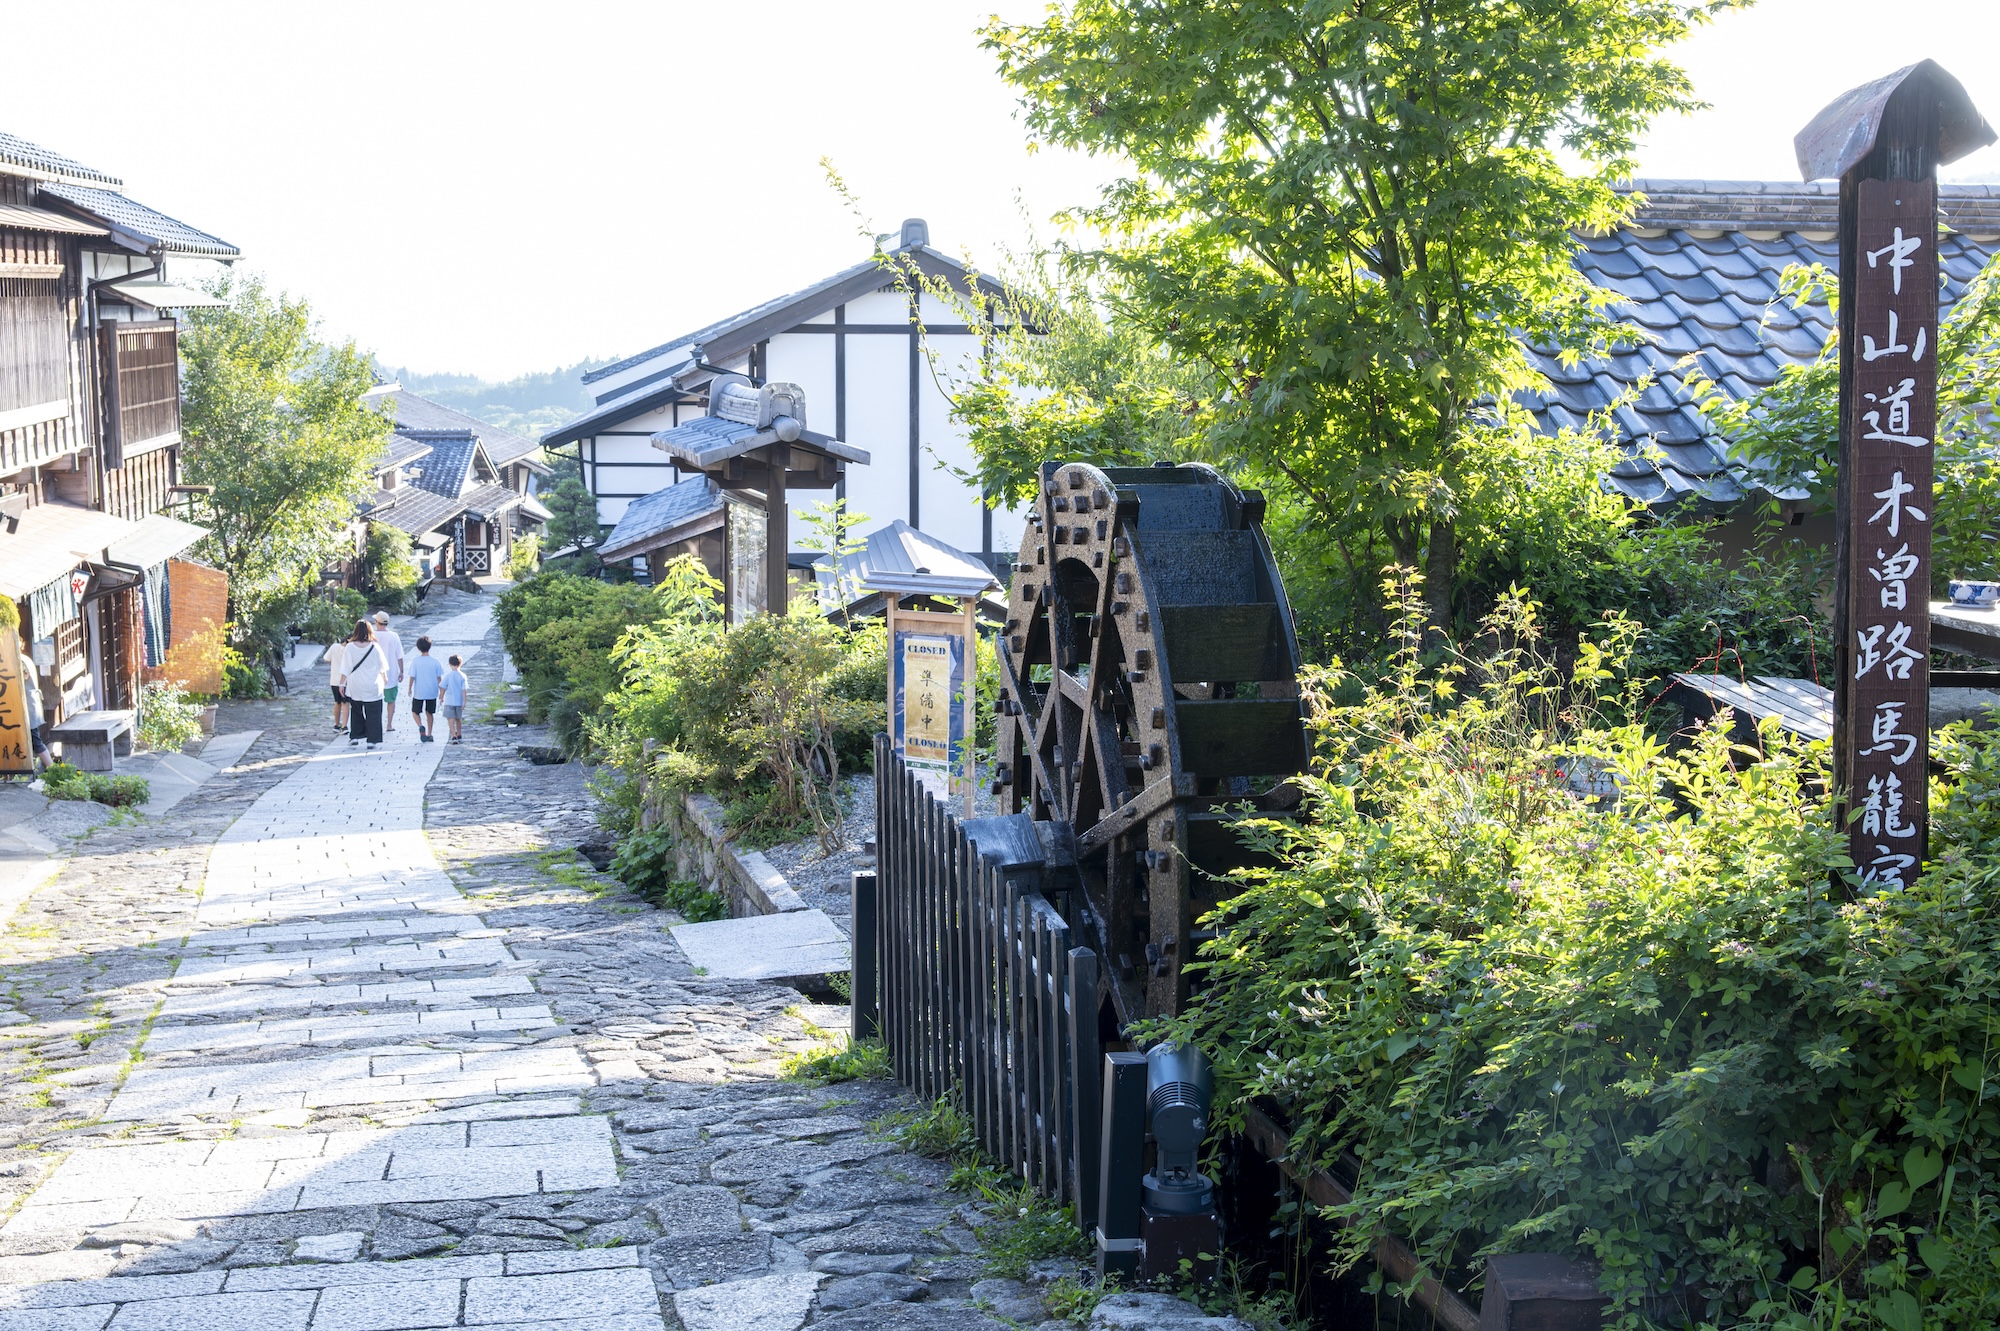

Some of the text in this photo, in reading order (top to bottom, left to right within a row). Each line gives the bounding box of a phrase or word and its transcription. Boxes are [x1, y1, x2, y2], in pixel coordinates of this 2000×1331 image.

[71, 578, 85, 594] 氷
[908, 644, 946, 655] CLOSED
[919, 669, 934, 730] 準備中
[909, 737, 946, 749] CLOSED
